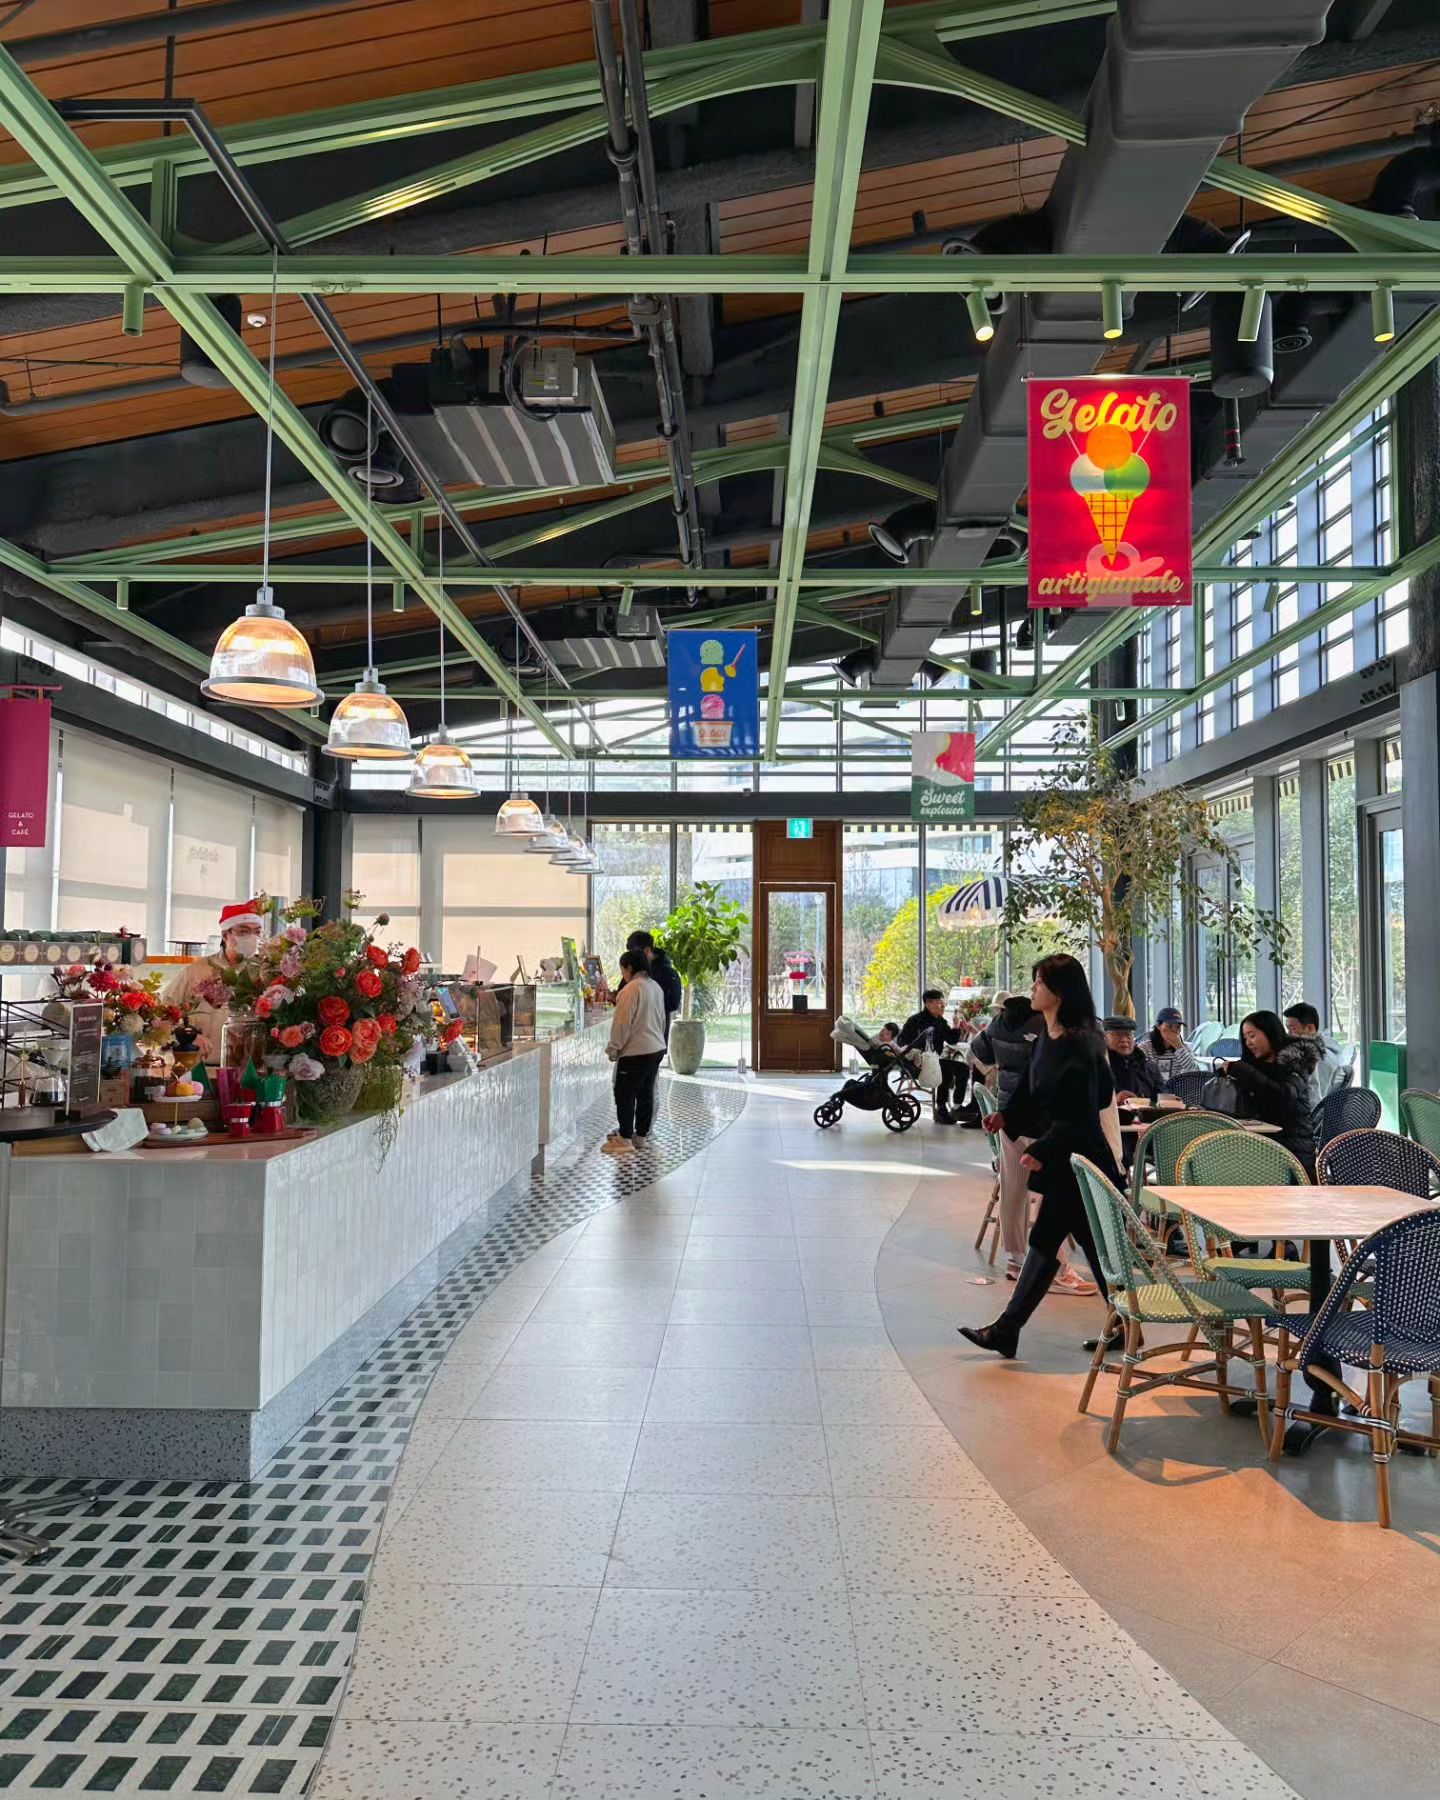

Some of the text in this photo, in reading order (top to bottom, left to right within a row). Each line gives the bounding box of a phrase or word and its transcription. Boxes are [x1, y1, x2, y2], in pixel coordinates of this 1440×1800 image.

[1040, 388, 1178, 439] Gelato
[1037, 569, 1184, 602] artigianale
[920, 787, 965, 806] Sweet
[920, 805, 965, 817] explosion
